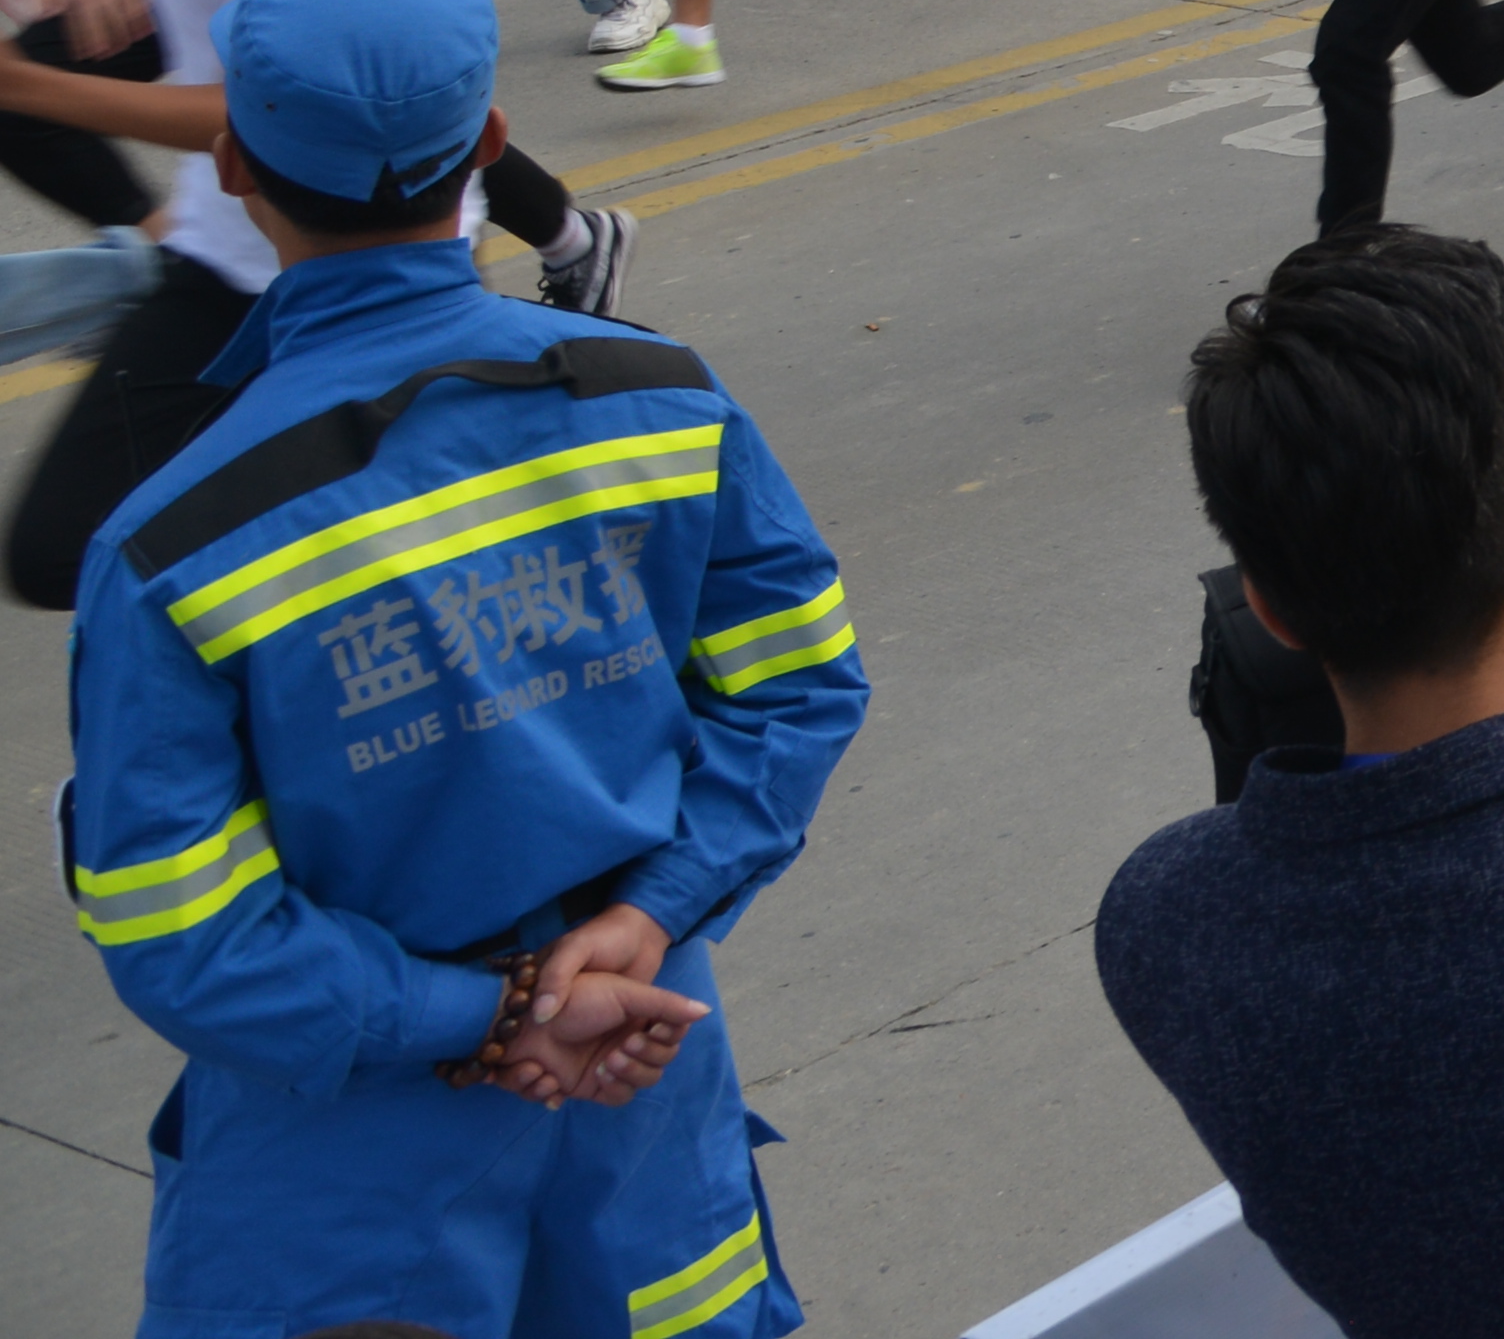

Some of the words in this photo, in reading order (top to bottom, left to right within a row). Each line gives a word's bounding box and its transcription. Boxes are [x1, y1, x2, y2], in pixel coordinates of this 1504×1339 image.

[317, 519, 650, 720] 蓝豹救援
[346, 712, 446, 774] BLUE
